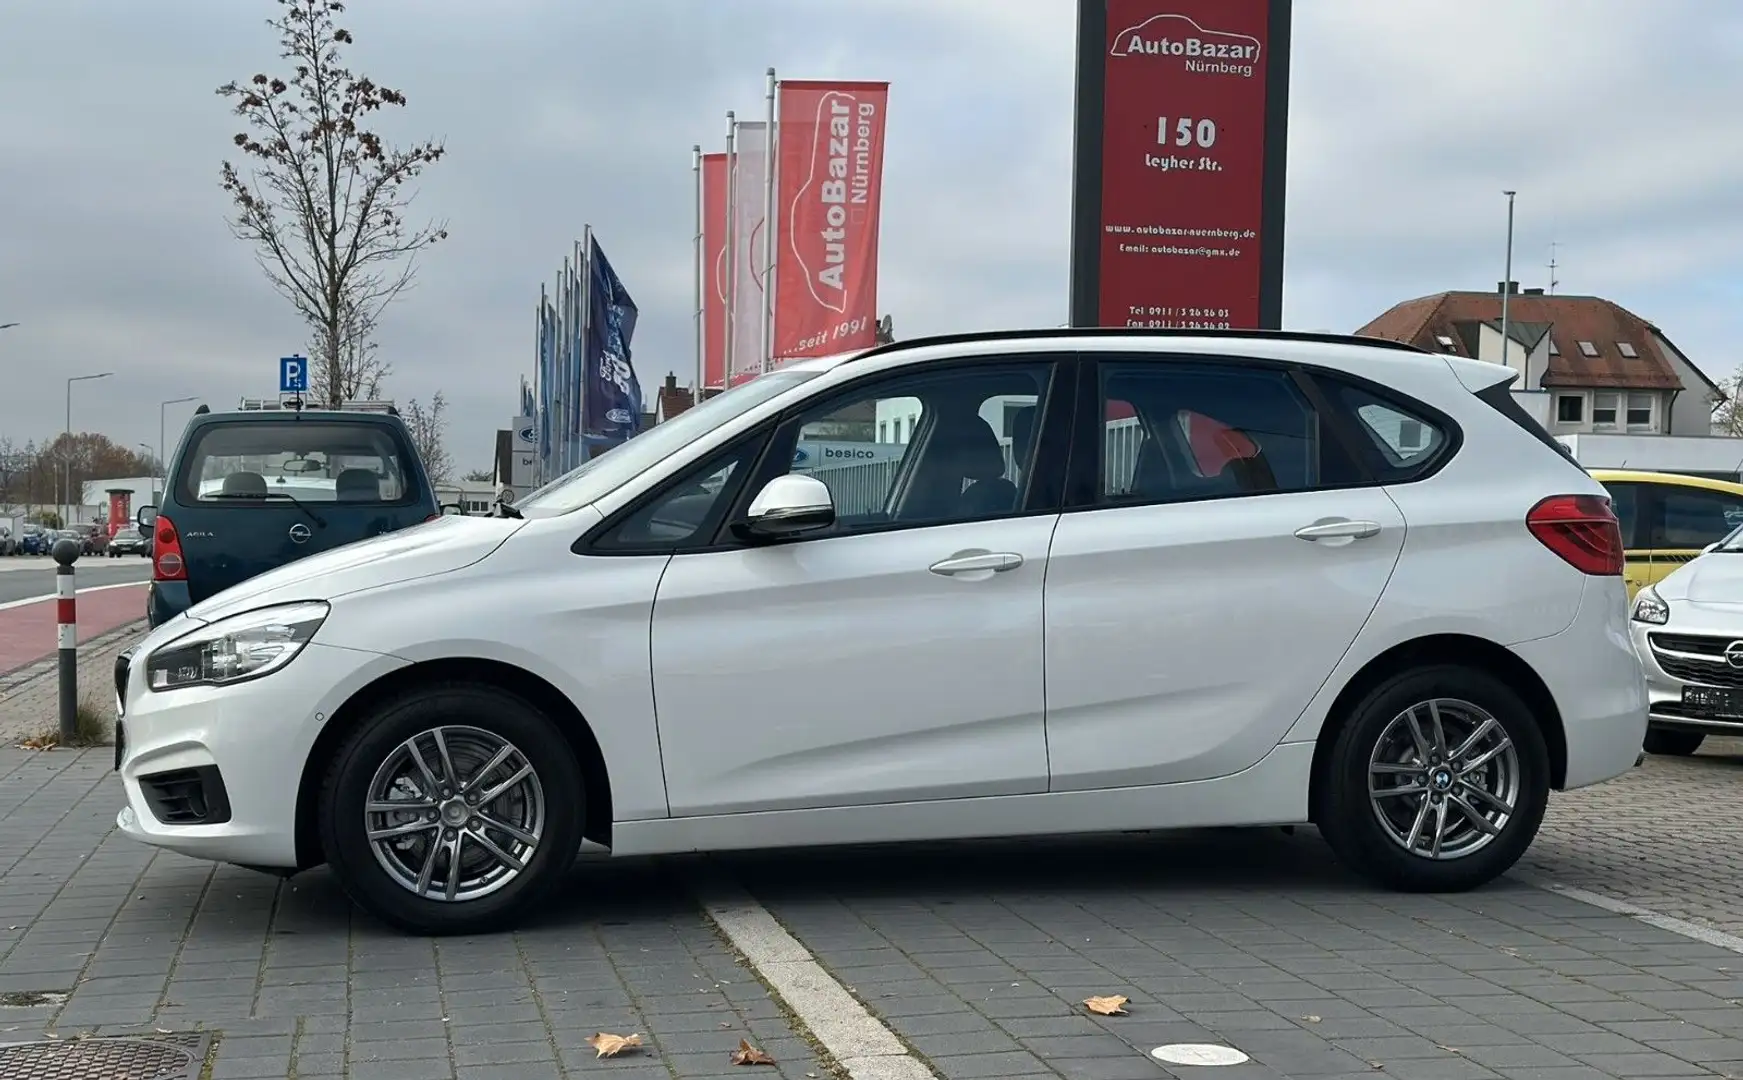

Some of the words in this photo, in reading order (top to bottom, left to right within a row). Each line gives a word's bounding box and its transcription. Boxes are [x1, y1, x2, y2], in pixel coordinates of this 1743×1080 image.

[1127, 35, 1255, 59] AutoBazar
[1185, 60, 1252, 77] Nürnberg
[1157, 116, 1217, 148] 150
[851, 103, 874, 204] Nürnberg
[1145, 153, 1194, 172] Leyher
[1198, 156, 1223, 172] Str.
[818, 100, 850, 290] AutoBazar
[1119, 243, 1149, 253] Email:
[1151, 246, 1241, 257] autobazar@gmx.de
[1129, 305, 1144, 315] Tel
[832, 316, 868, 341] 1991
[286, 361, 301, 388] P
[825, 447, 874, 459] besico
